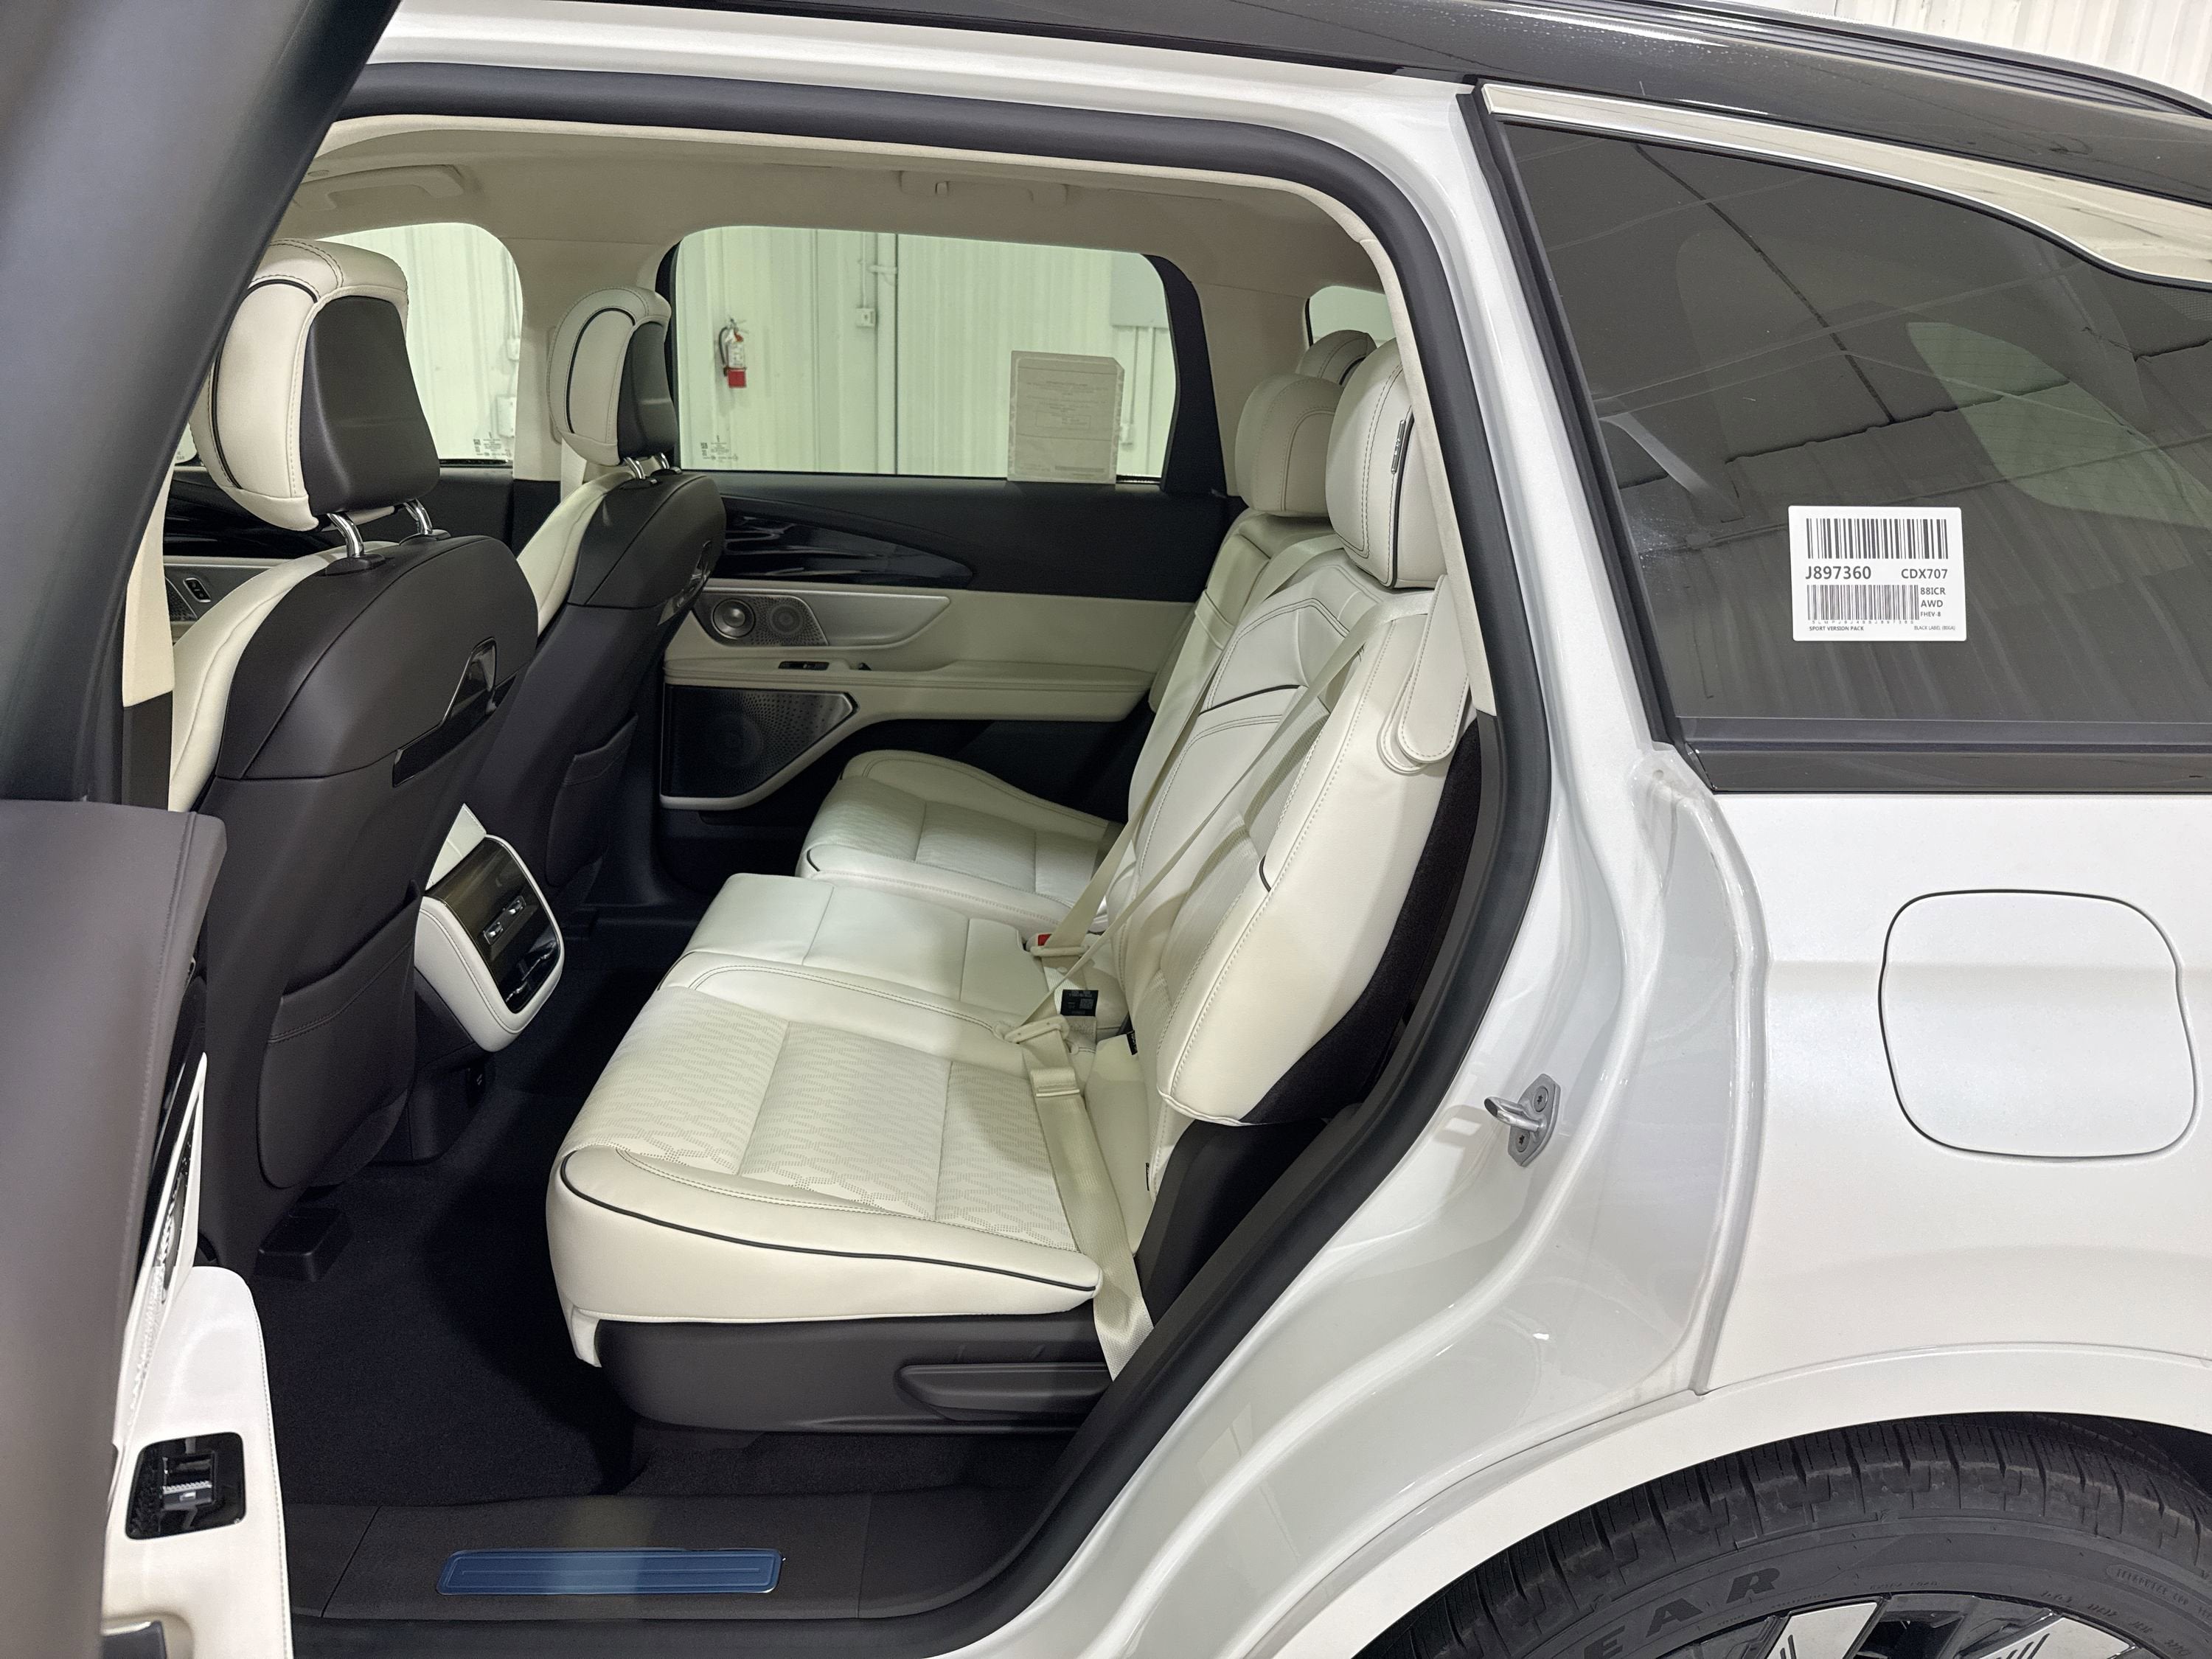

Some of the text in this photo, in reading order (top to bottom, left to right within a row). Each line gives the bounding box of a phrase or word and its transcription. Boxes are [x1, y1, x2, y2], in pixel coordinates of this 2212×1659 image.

[1805, 566, 1948, 580] J897360 CDX707
[1920, 587, 1947, 596] 88ICR
[1920, 599, 1944, 608] AWD
